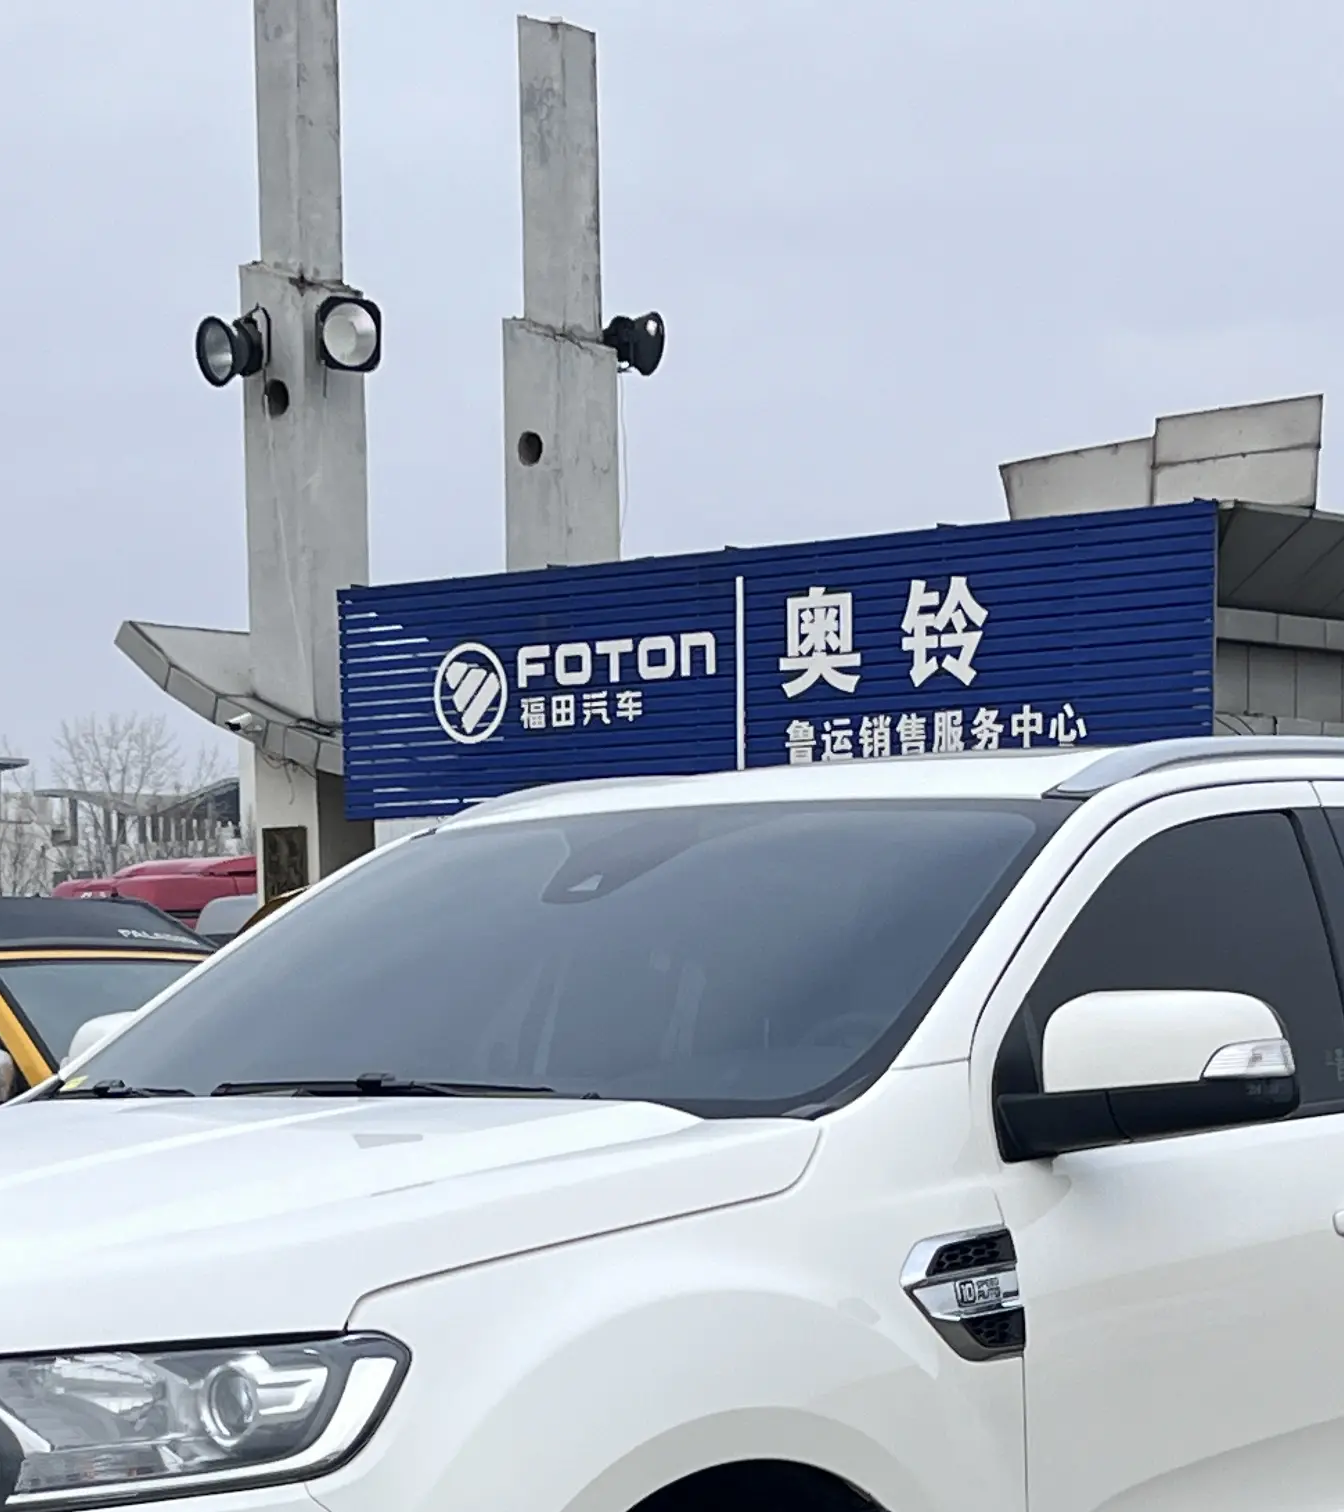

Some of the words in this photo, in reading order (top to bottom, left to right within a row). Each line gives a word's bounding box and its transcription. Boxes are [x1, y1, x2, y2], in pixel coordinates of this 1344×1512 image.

[517, 630, 716, 689] FOTON
[778, 575, 989, 698] 奥铃
[520, 690, 644, 729] 福田汽车
[784, 702, 1088, 766] 鲁运销售服务中心
